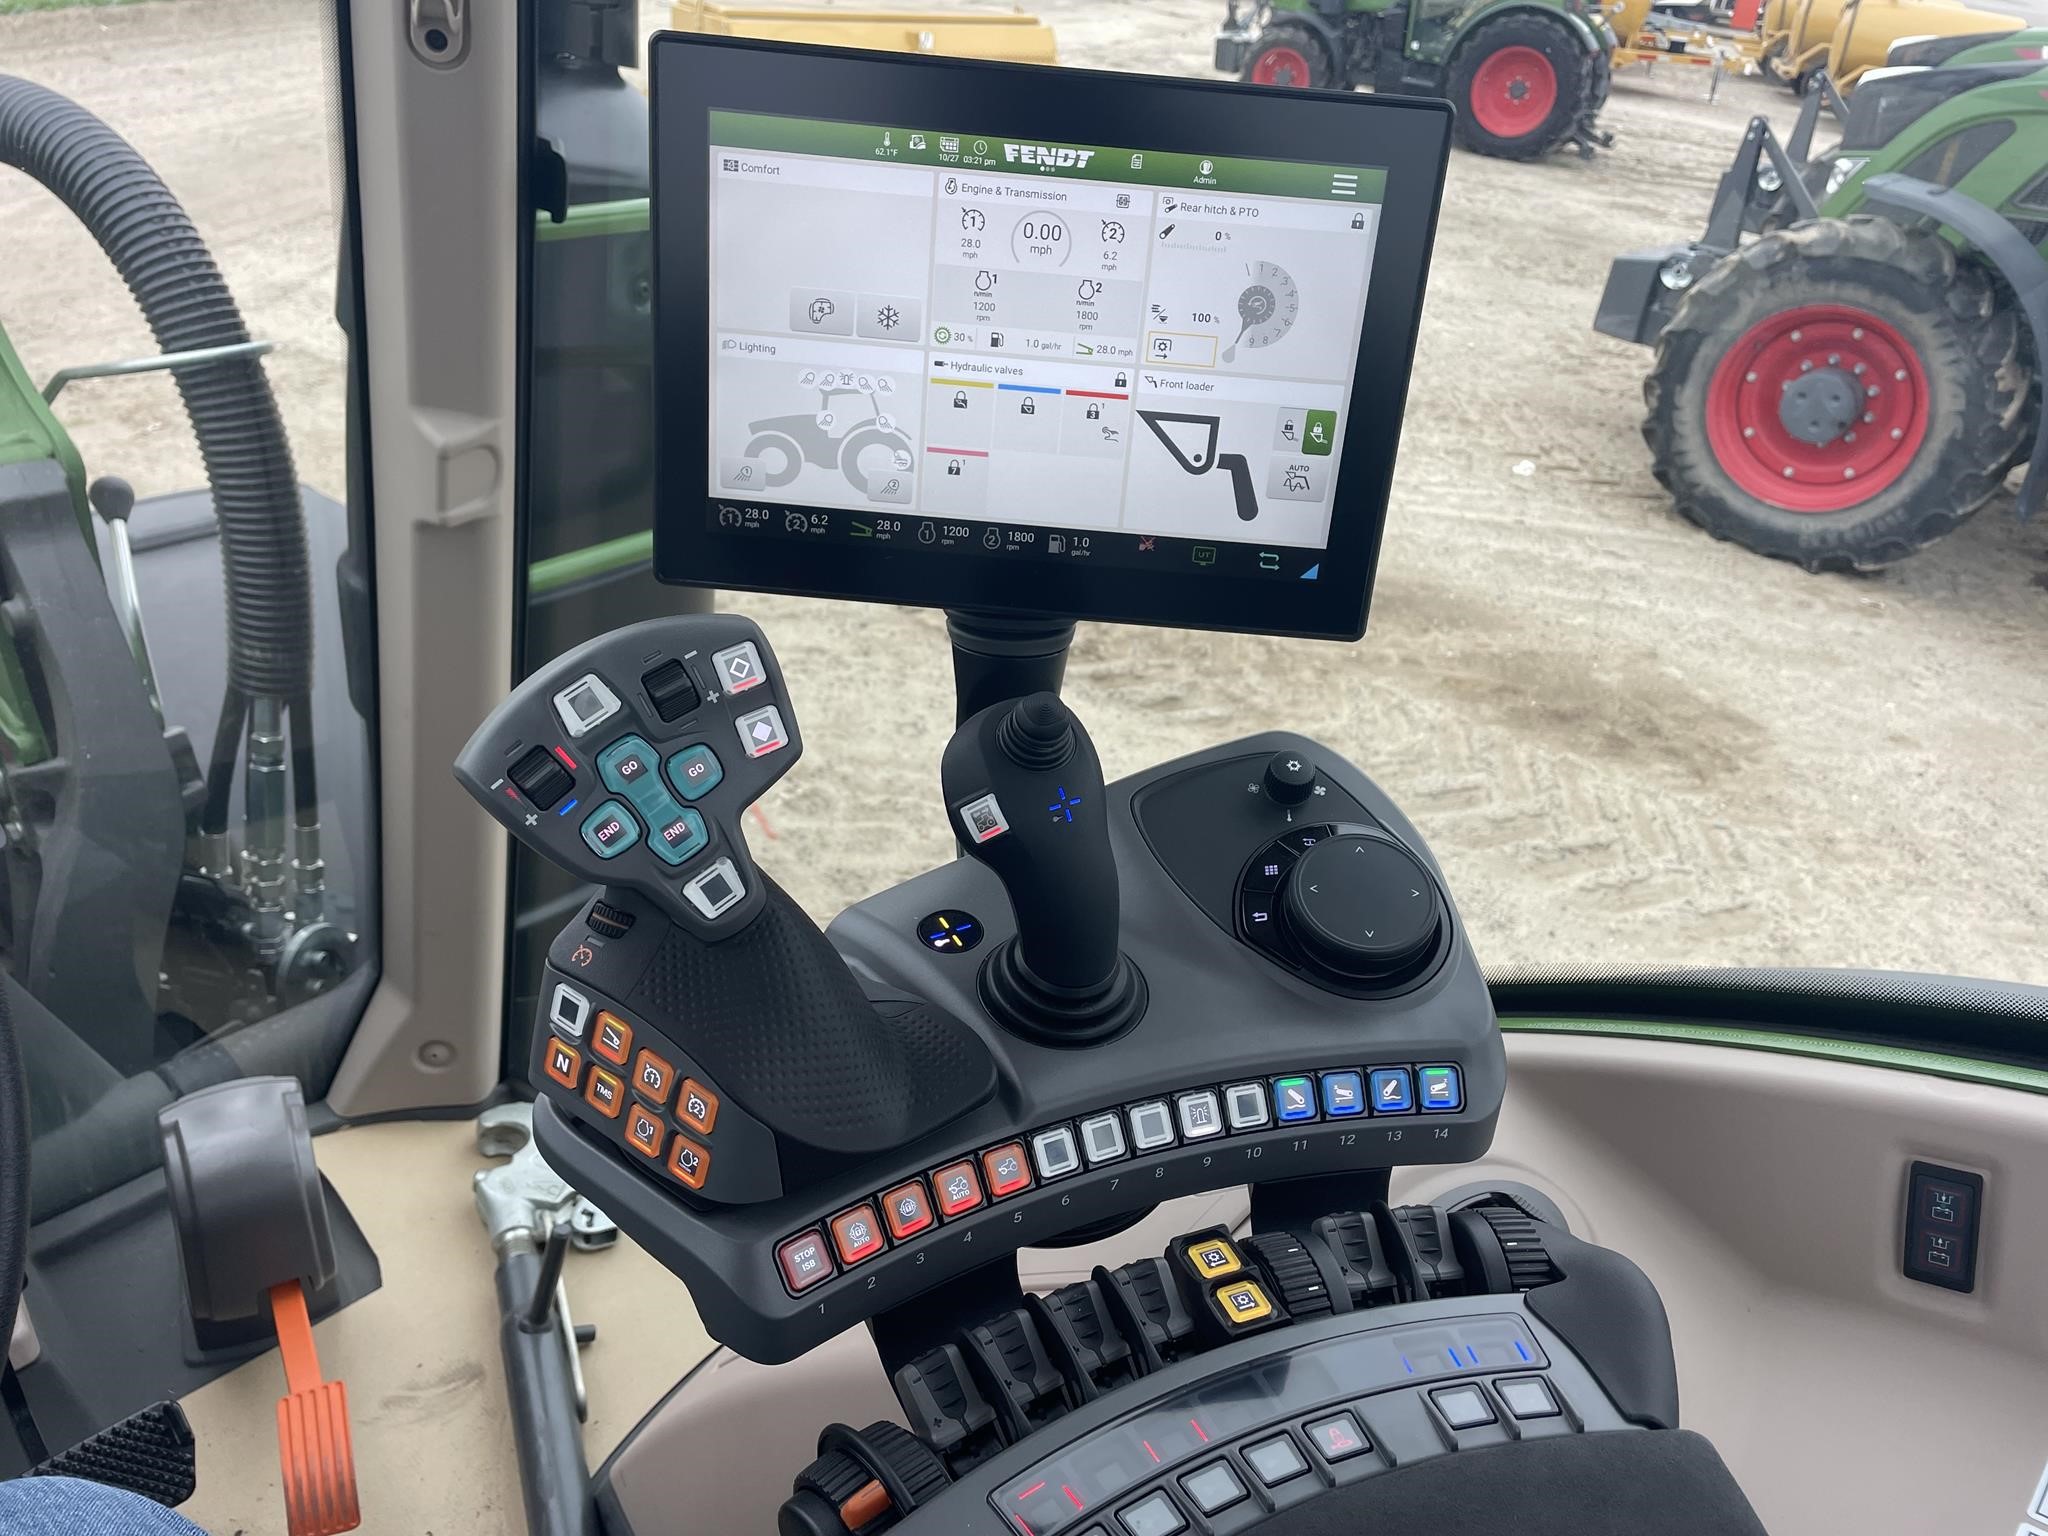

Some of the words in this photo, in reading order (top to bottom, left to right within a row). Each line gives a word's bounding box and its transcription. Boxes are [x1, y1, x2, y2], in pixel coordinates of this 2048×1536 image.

[939, 154, 959, 162] 10/27
[964, 156, 982, 164] 03:21
[1004, 144, 1095, 169] FENDT
[741, 163, 780, 175] Comfort
[1193, 176, 1216, 185] Admin
[962, 184, 993, 195] Engine
[996, 186, 1002, 195] &
[1005, 187, 1067, 201] Transmission
[1181, 202, 1202, 212] Rear
[1204, 204, 1227, 215] hitch
[1230, 207, 1236, 216] &
[1239, 207, 1259, 217] PTO
[1024, 223, 1062, 241] 0.00
[1215, 231, 1222, 241] 0
[961, 238, 981, 249] 28.0
[963, 251, 978, 259] mph
[1030, 245, 1052, 256] mph
[1103, 251, 1117, 261] 6.2
[1102, 263, 1117, 271] mph
[992, 274, 997, 284] 1
[1095, 283, 1102, 293] 2
[974, 302, 996, 312] 1200
[1076, 311, 1098, 321] 1800
[1192, 312, 1211, 323] 100
[954, 332, 966, 342] 30
[740, 342, 776, 355] Lighting
[1026, 338, 1039, 348] 1.0
[1041, 342, 1062, 351] gal/hr
[1097, 345, 1116, 355] 28.0
[1118, 348, 1133, 357] mph
[950, 361, 992, 374] Hydraulic
[994, 364, 1024, 376] valves
[1160, 379, 1183, 390] Front
[1184, 381, 1215, 392] loader
[1289, 464, 1309, 472] AUTO
[745, 508, 769, 519] 28.0
[745, 521, 760, 529] mph
[811, 514, 828, 525] 6.2
[811, 526, 825, 534] mph
[877, 520, 901, 531] 28.0
[942, 525, 969, 537] 1200
[876, 532, 891, 540] mph
[1008, 531, 1035, 543] 1800
[1073, 537, 1089, 547] 1.0
[1071, 549, 1091, 557] gal/hr
[622, 760, 639, 776] GO
[688, 763, 705, 778] GO
[598, 822, 620, 843] END
[663, 822, 686, 842] END
[556, 1054, 569, 1073] N
[596, 1082, 613, 1101] TMS
[649, 1126, 654, 1135] 1
[1387, 1131, 1402, 1141] 13
[1434, 1128, 1449, 1139] 14
[1293, 1140, 1308, 1151] 11
[1340, 1135, 1356, 1146] 12
[1246, 1147, 1262, 1159] 10
[693, 1157, 699, 1167] 2
[1203, 1157, 1212, 1167] 9
[1156, 1168, 1164, 1178] 8
[1110, 1179, 1119, 1191] 7
[952, 1188, 970, 1201] AUTO
[1062, 1195, 1070, 1206] 6
[1014, 1212, 1022, 1223] 5
[853, 1235, 870, 1248] AUTO
[963, 1231, 972, 1243] 4
[794, 1246, 816, 1263] STOP
[916, 1253, 925, 1264] 3
[802, 1258, 816, 1272] ISB
[867, 1276, 876, 1289] 2
[818, 1303, 825, 1314] 1
